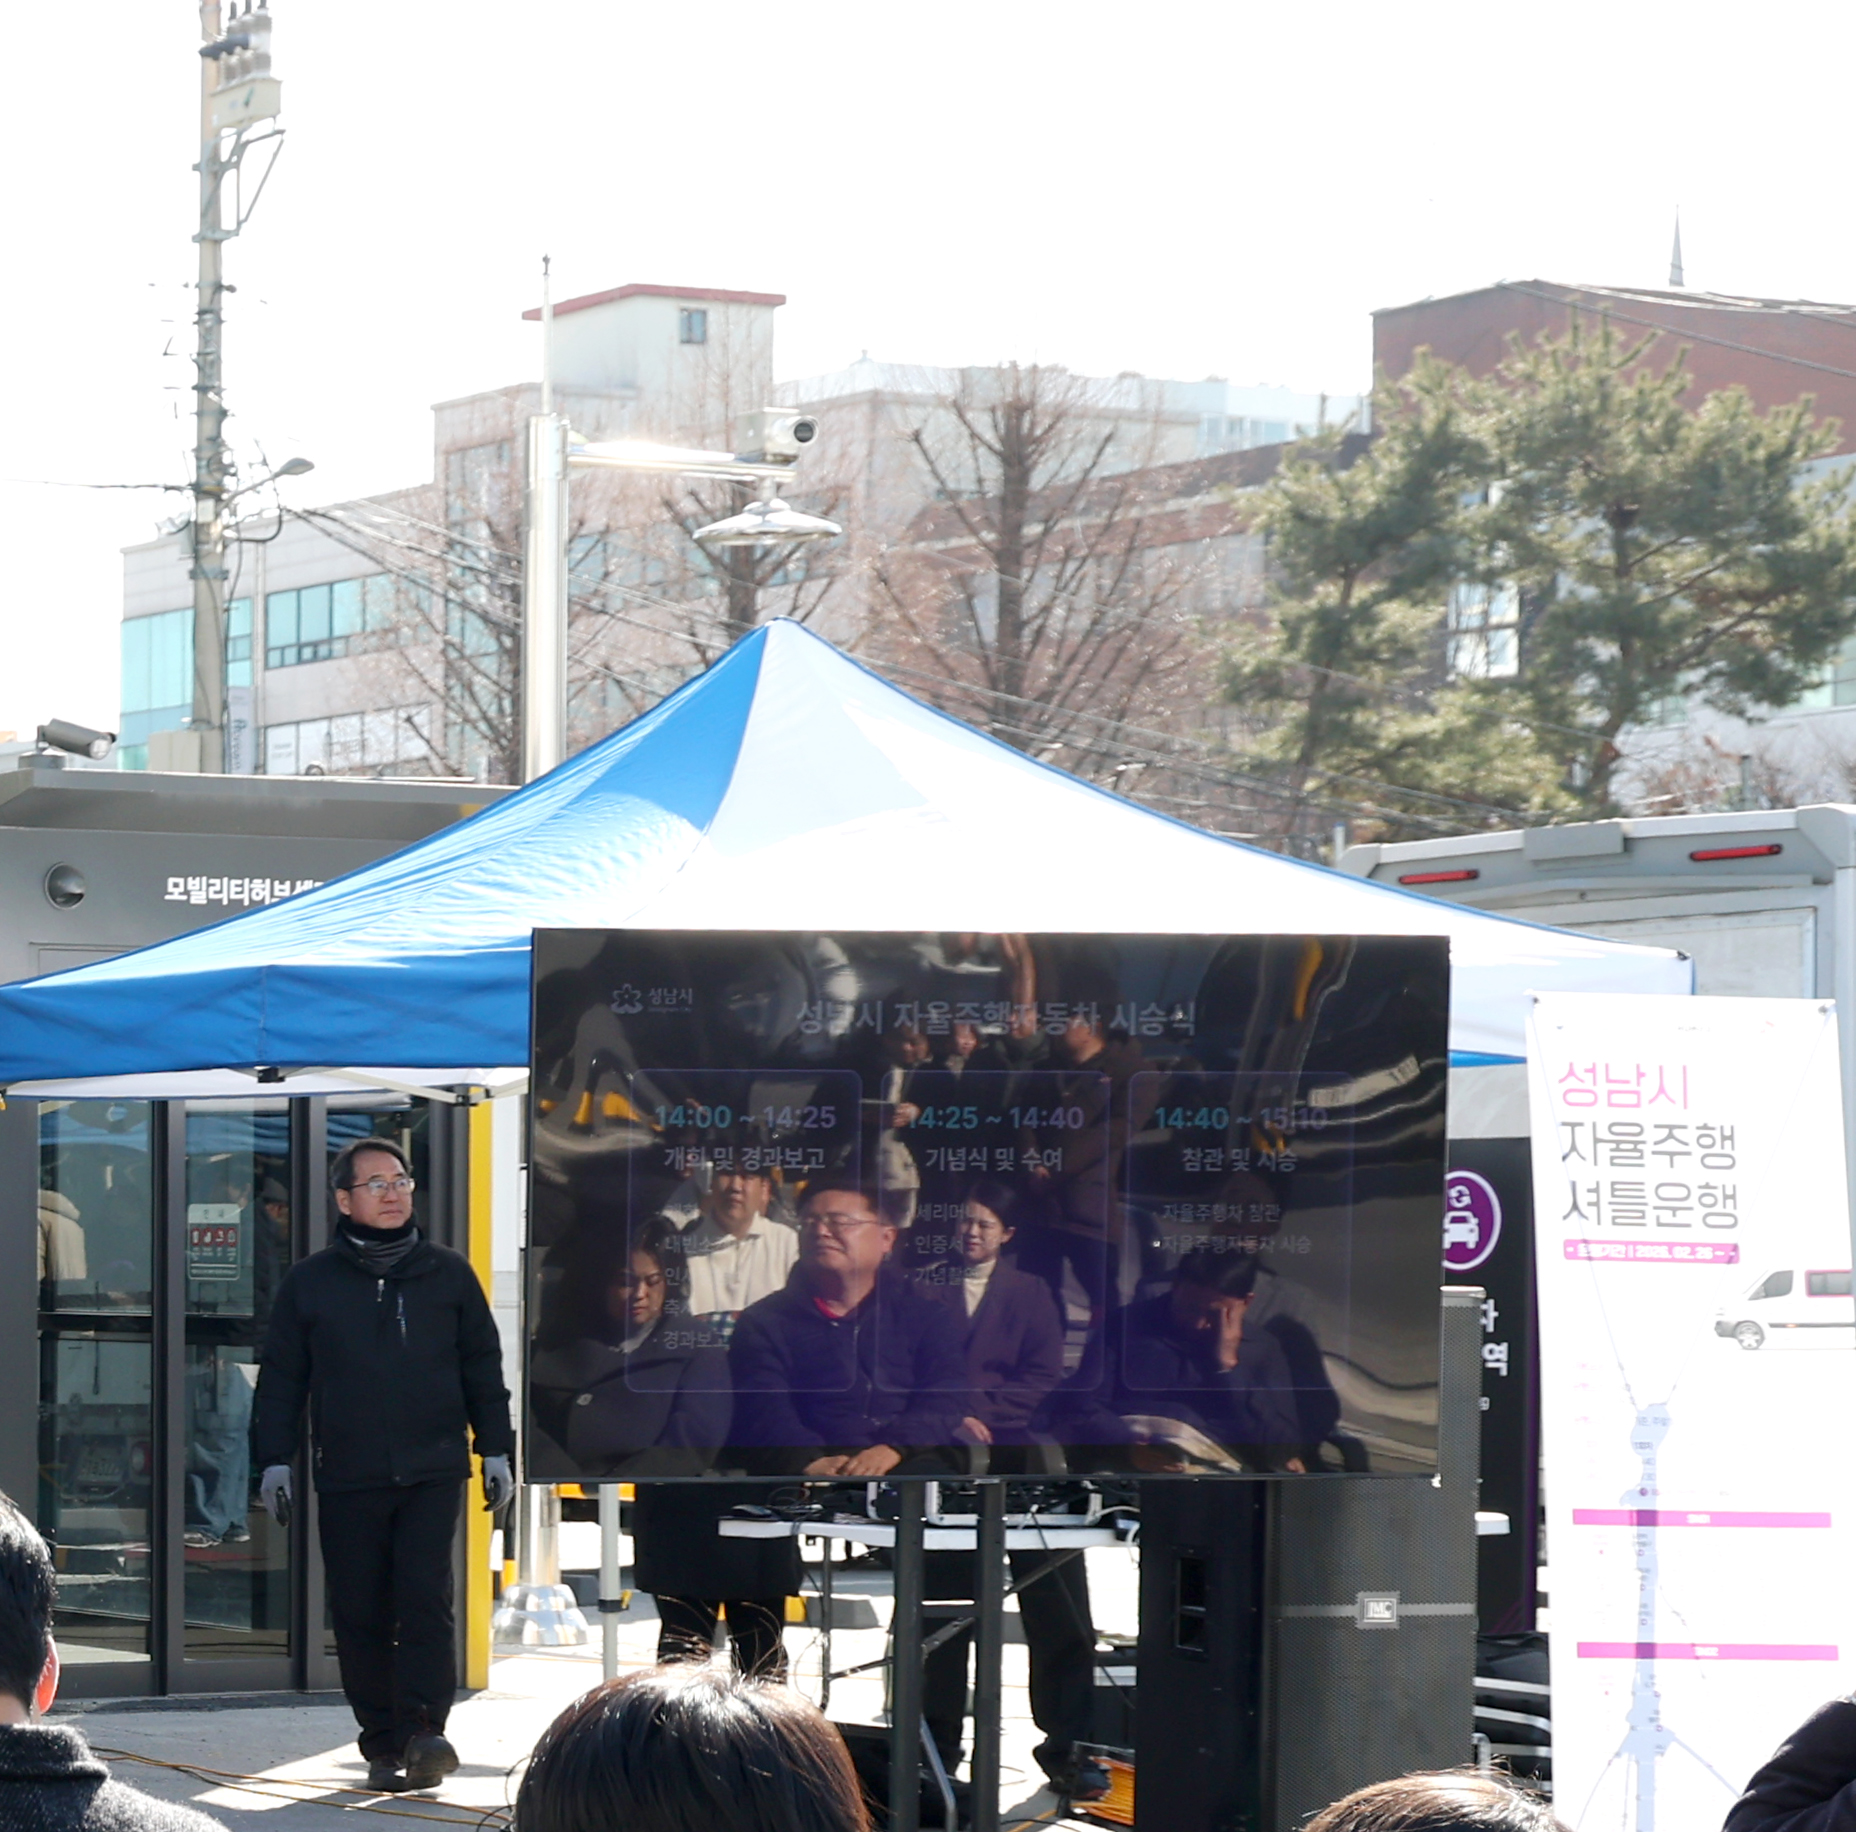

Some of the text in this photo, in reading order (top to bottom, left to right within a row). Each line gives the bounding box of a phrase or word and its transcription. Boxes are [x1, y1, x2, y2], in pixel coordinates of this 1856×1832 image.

[164, 875, 325, 907] 모빌리티허브
[648, 987, 693, 1006] 성남시
[797, 1000, 1198, 1037] 성남시 자율주행자동차 시승식
[1558, 1061, 1689, 1110] 성남시
[655, 1105, 732, 1129] 14:00
[763, 1105, 837, 1129] 14:25
[1009, 1106, 1085, 1130] 14:40
[1155, 1106, 1229, 1130] 14:40
[1559, 1120, 1738, 1172] 자율주행
[715, 1148, 734, 1171] 및
[742, 1147, 826, 1171] 경과보고
[926, 1147, 1063, 1172] 기념식 및 수여
[1182, 1147, 1226, 1172] 참관
[1231, 1148, 1251, 1172] 및
[1561, 1180, 1740, 1231] 셔틀운행
